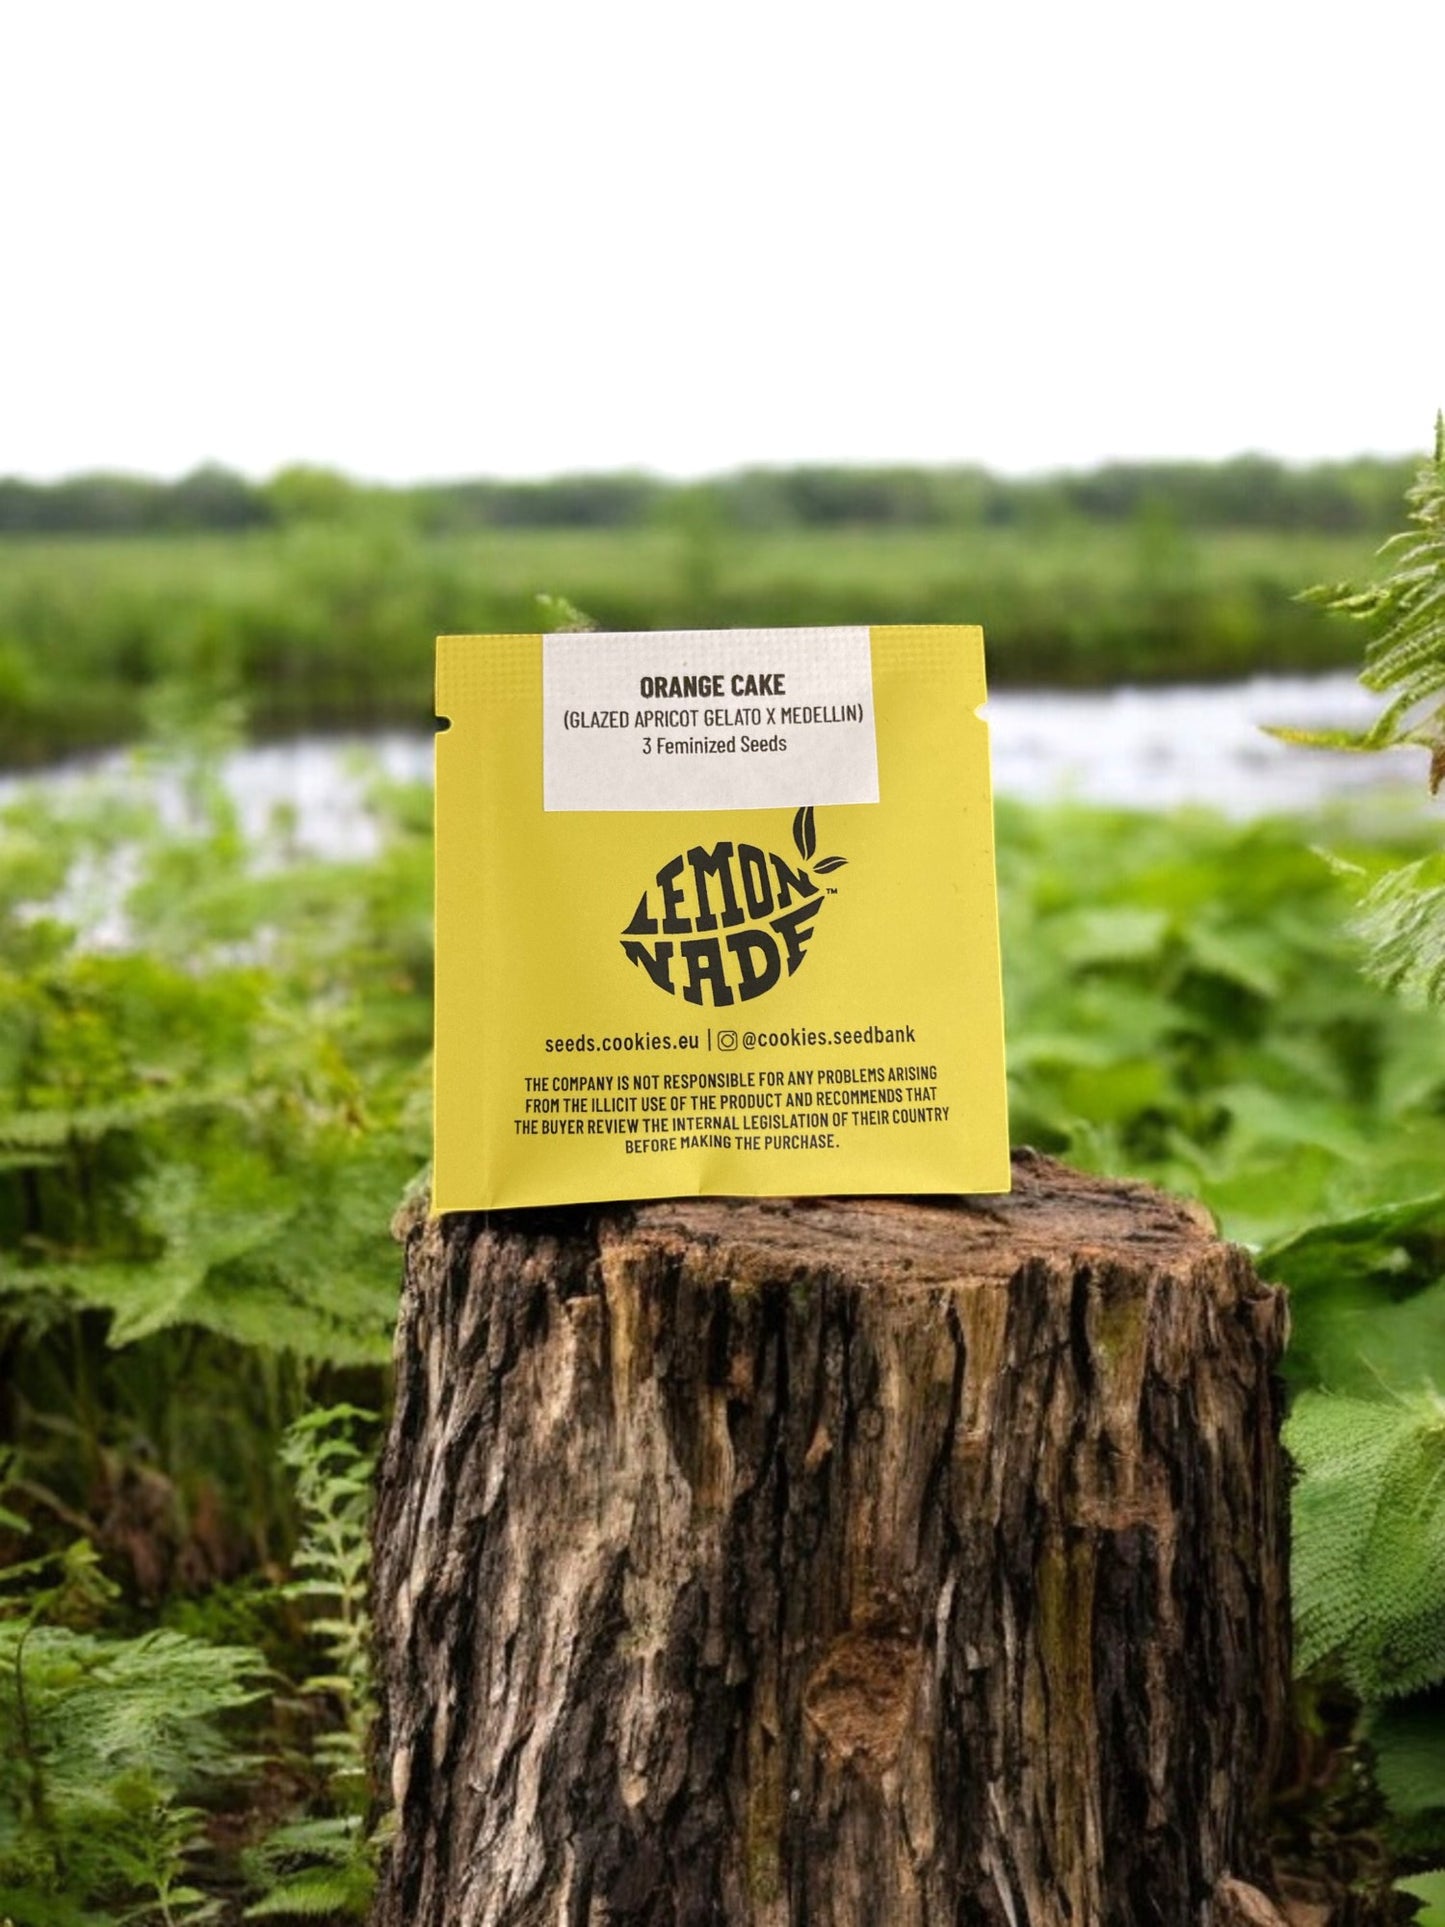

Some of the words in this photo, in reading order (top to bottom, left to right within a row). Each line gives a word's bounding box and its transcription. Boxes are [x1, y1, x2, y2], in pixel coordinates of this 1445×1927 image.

[640, 675, 725, 699] ORANGE
[731, 674, 786, 697] CAKE
[564, 710, 629, 730] (GLAZED
[634, 710, 699, 728] APRICOT
[704, 708, 761, 727] GELATO
[766, 708, 776, 725] X
[781, 703, 863, 724] MEDELLIN)
[642, 737, 652, 755] 3
[657, 736, 736, 754] Feminized
[741, 734, 787, 753] Seeds
[621, 841, 820, 934] LEMON
[619, 896, 825, 1007] NADE
[545, 1032, 699, 1052] seeds.cookies.eu
[742, 1025, 915, 1050] @cookies.seedbank
[524, 1077, 549, 1092] THE
[552, 1076, 613, 1092] COMPANY
[617, 1075, 629, 1090] IS
[633, 1075, 660, 1090] NOT
[664, 1072, 755, 1089] RESPONSIBLE
[759, 1071, 784, 1087] FOR
[787, 1070, 814, 1086] ANY
[818, 1067, 885, 1085] PROBLEMS
[888, 1065, 937, 1082] ARISING
[526, 1098, 559, 1113] FROM
[563, 1098, 588, 1113] THE
[592, 1097, 637, 1112] ILLICIT
[641, 1096, 667, 1112] USE
[670, 1096, 687, 1111] OF
[690, 1095, 717, 1110] THE
[720, 1093, 782, 1109] PRODUCT
[786, 1092, 813, 1107] AND
[816, 1088, 903, 1106] RECOMMENDS
[905, 1086, 937, 1102] THAT
[514, 1120, 538, 1135] THE
[542, 1119, 584, 1135] BUYER
[588, 1119, 639, 1134] REVIEW
[642, 1118, 669, 1133] THE
[672, 1116, 740, 1132] INTERNAL
[743, 1113, 829, 1130] LEGISLATION
[832, 1112, 848, 1127] OF
[851, 1110, 889, 1126] THEIR
[892, 1106, 949, 1124] COUNTRY
[625, 1137, 677, 1154] BEFORE
[680, 1134, 731, 1149] MAKING
[735, 1136, 761, 1150] THE
[765, 1134, 839, 1150] PURCHASE.
